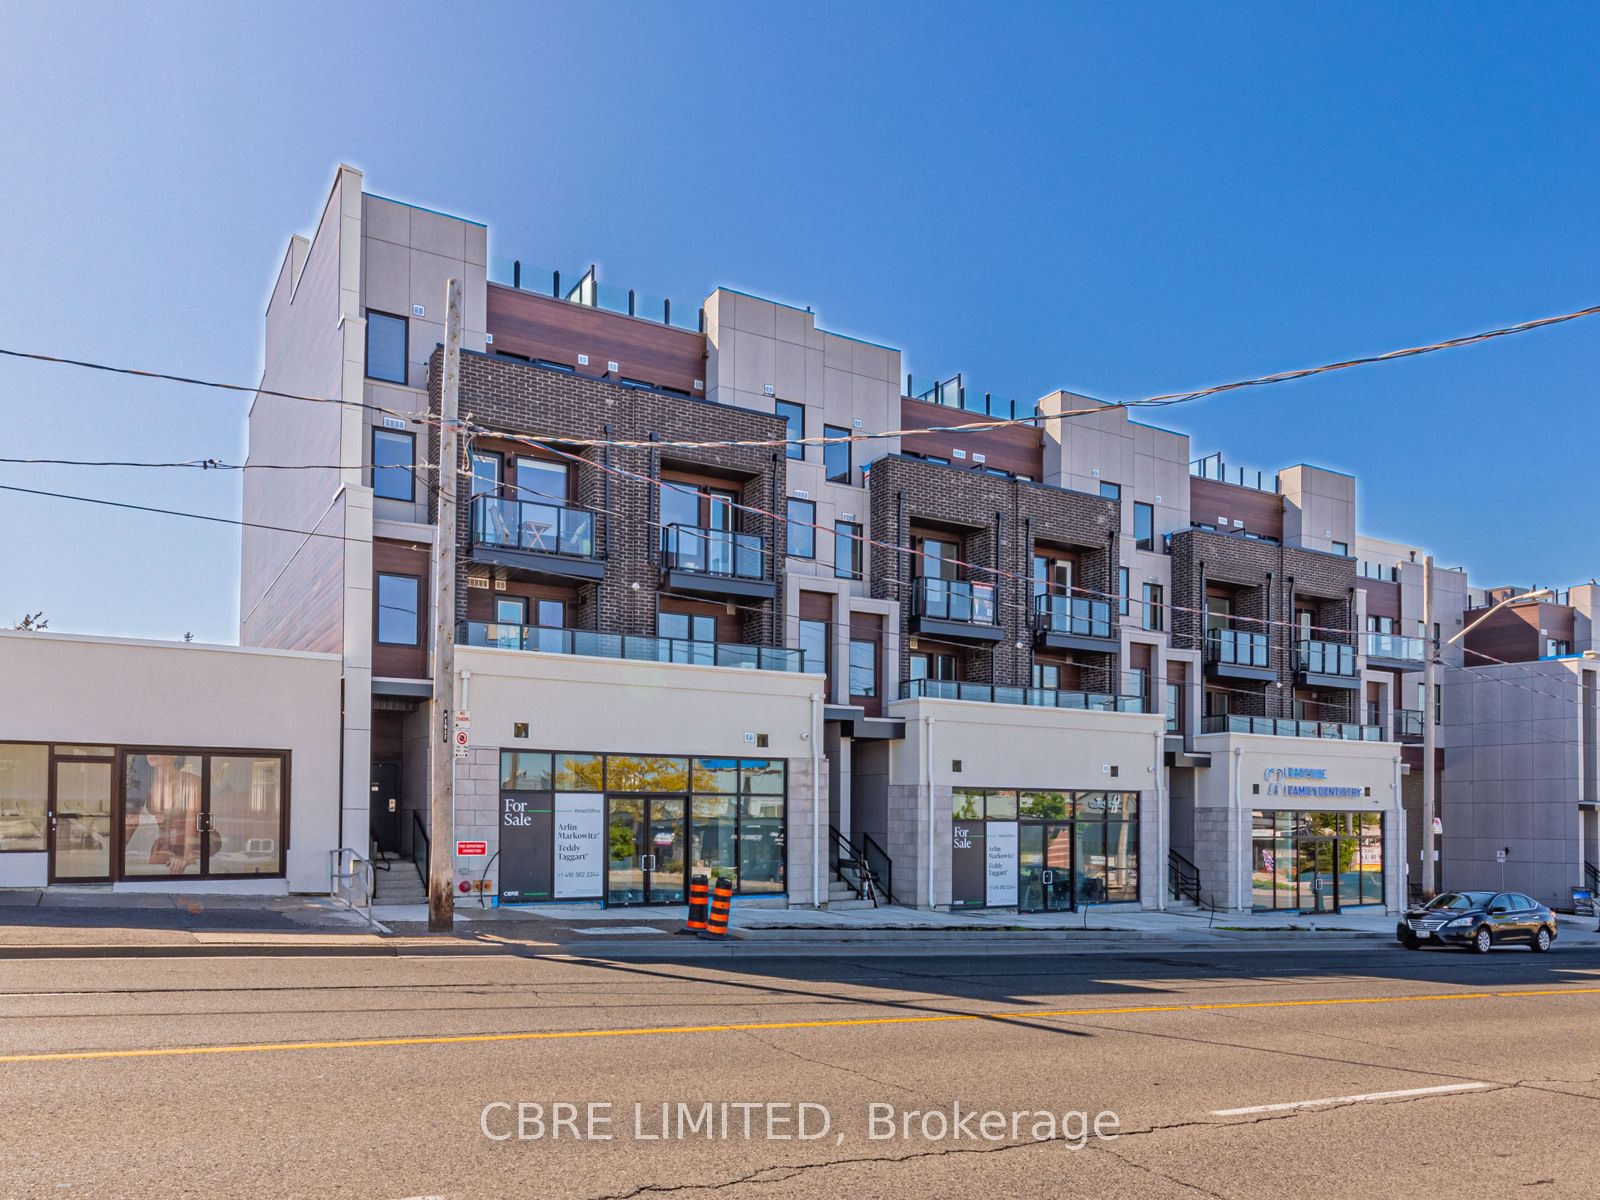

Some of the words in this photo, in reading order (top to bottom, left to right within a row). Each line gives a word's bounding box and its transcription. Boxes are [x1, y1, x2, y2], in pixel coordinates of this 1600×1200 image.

[1287, 785, 1317, 797] FAMILY
[1319, 786, 1361, 798] DENTISTRY
[504, 799, 527, 813] For
[504, 813, 532, 826] Sale
[559, 823, 577, 831] Arlin
[954, 826, 969, 837] For
[559, 844, 581, 852] Teddy
[953, 838, 972, 848] Sale
